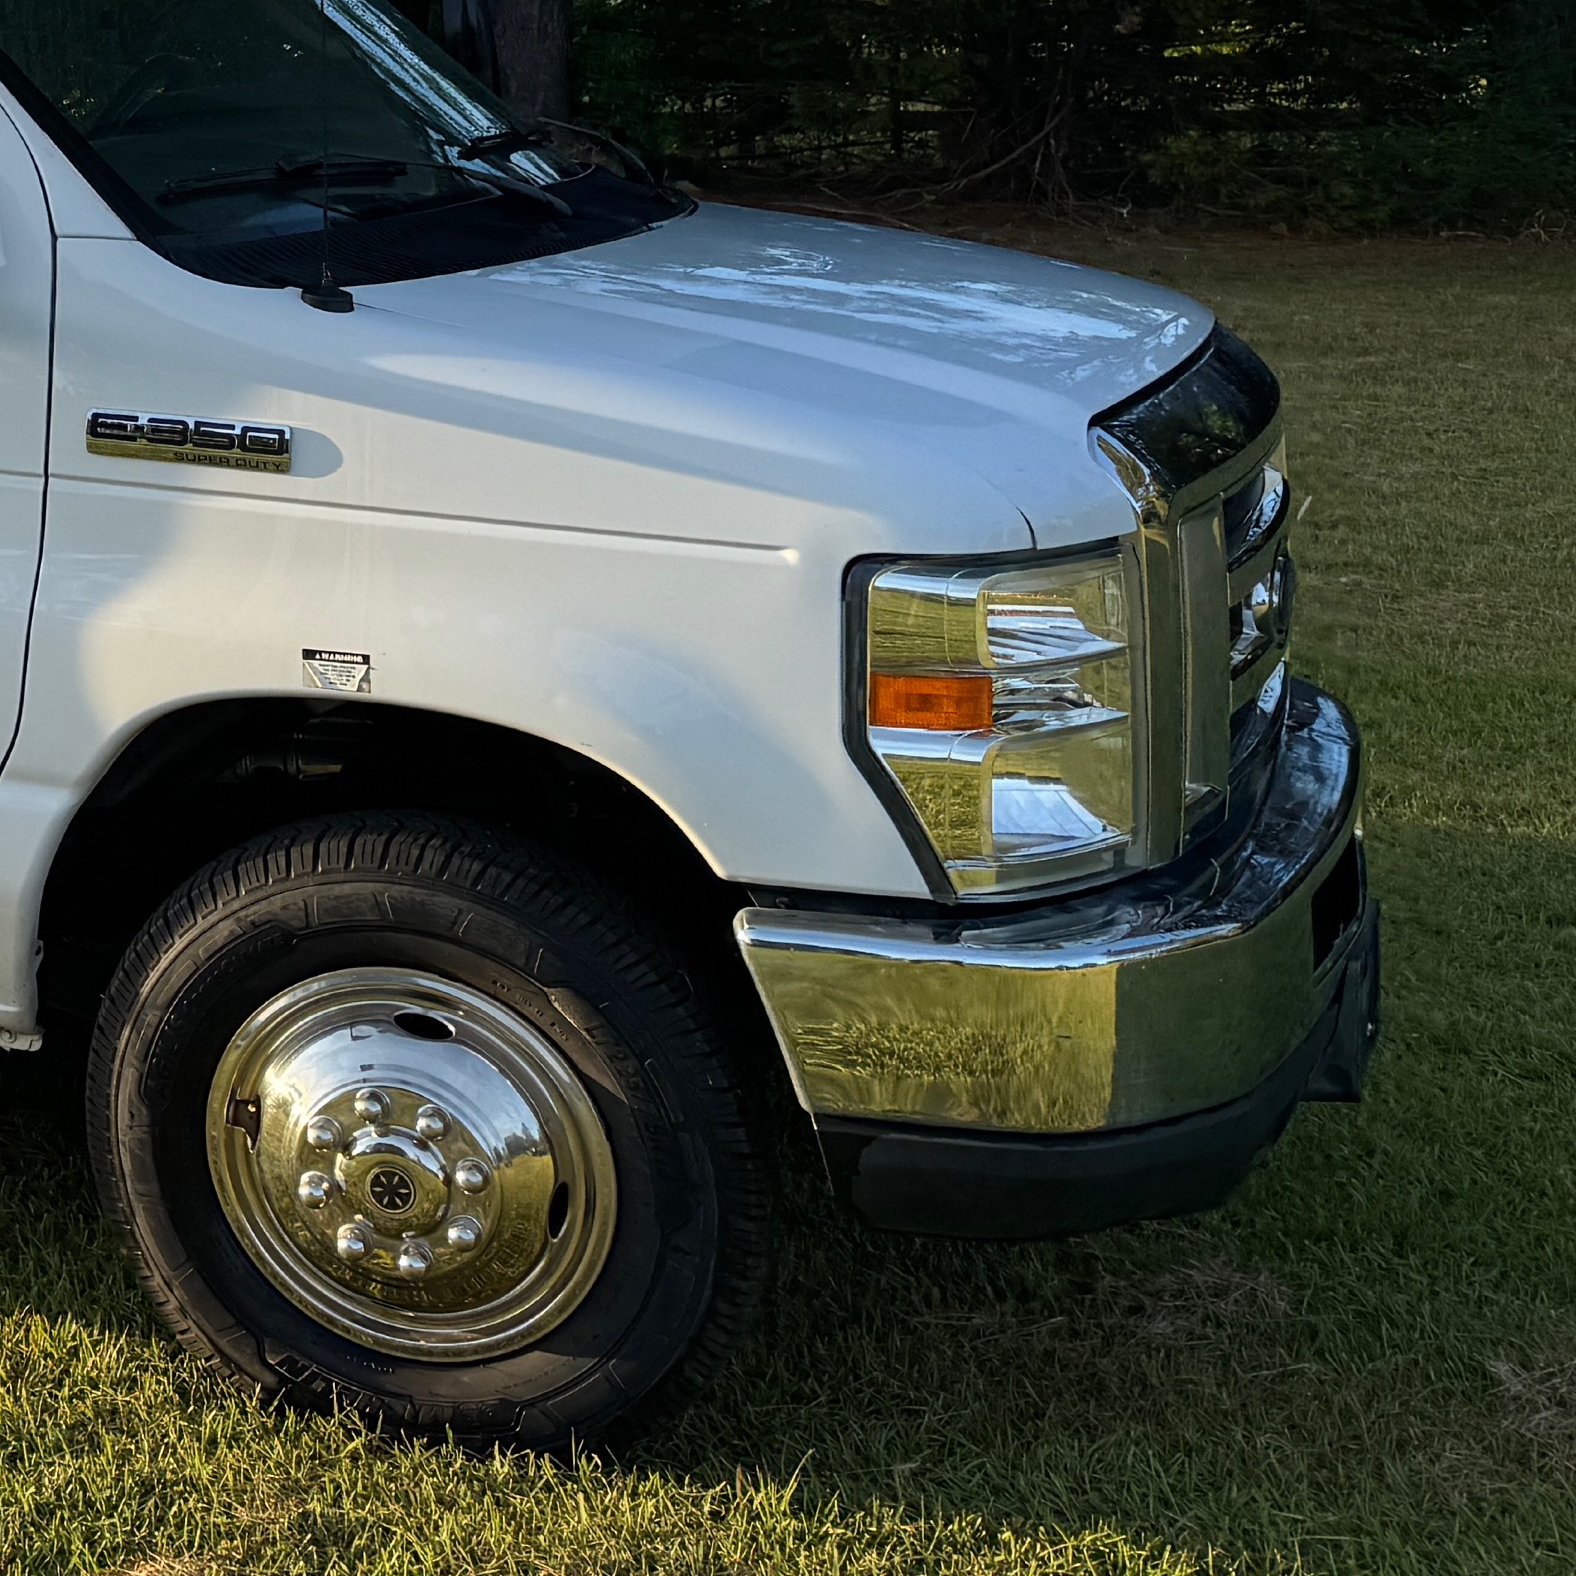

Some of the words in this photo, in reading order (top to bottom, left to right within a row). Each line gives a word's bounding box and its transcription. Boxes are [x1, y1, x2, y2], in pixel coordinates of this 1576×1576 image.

[173, 451, 230, 466] SUPER
[235, 457, 284, 472] DUTY
[321, 652, 364, 663] WARNING
